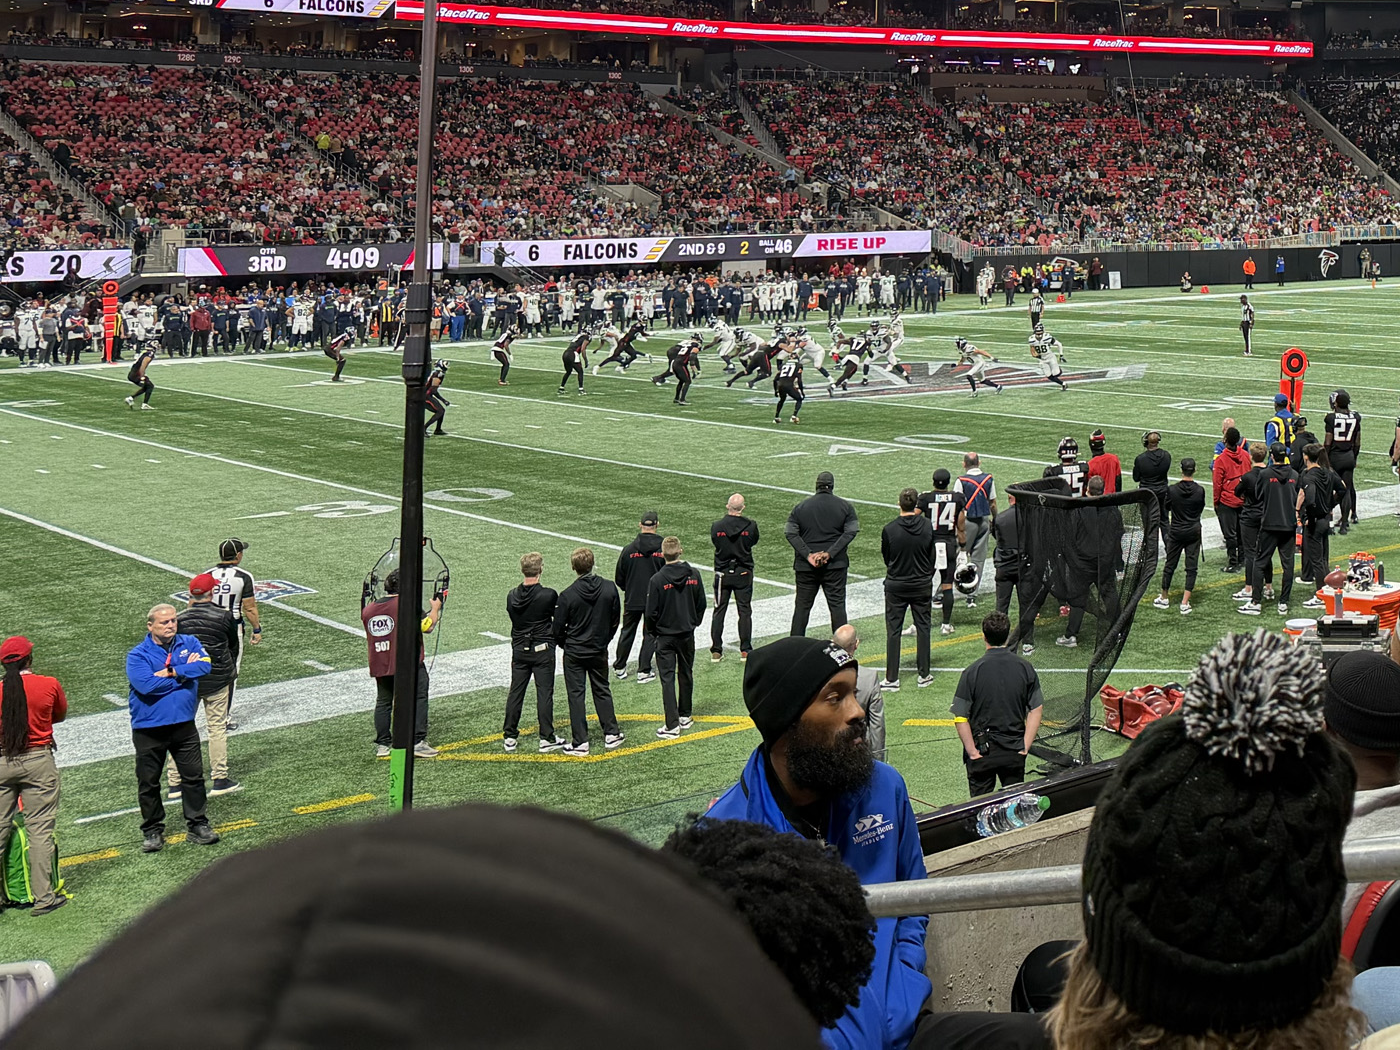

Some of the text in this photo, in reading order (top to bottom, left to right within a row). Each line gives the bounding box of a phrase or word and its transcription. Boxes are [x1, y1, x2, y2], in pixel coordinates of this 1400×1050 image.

[437, 6, 491, 21] RaceTrac
[672, 22, 719, 34] RaceTrac
[890, 31, 936, 42] RaceTrac
[1093, 38, 1134, 48] RaceTrac
[1274, 44, 1311, 54] RaceTrac
[259, 247, 276, 255] QTR
[678, 242, 726, 256] 2ND & 9
[740, 241, 750, 255] 2
[759, 240, 775, 248] BALL
[775, 239, 793, 253] 46
[817, 236, 887, 252] RISE UP
[326, 248, 380, 269] 4:09
[528, 242, 638, 262] 6 FALCONS
[50, 254, 82, 277] 20
[248, 255, 287, 273] 3RD
[851, 338, 866, 351] 17
[780, 364, 796, 378] 21
[1333, 419, 1357, 441] 27
[927, 502, 956, 531] 14
[372, 619, 389, 628] FOX
[375, 641, 390, 653] 507
[852, 822, 894, 845] Mercedes-Benz
